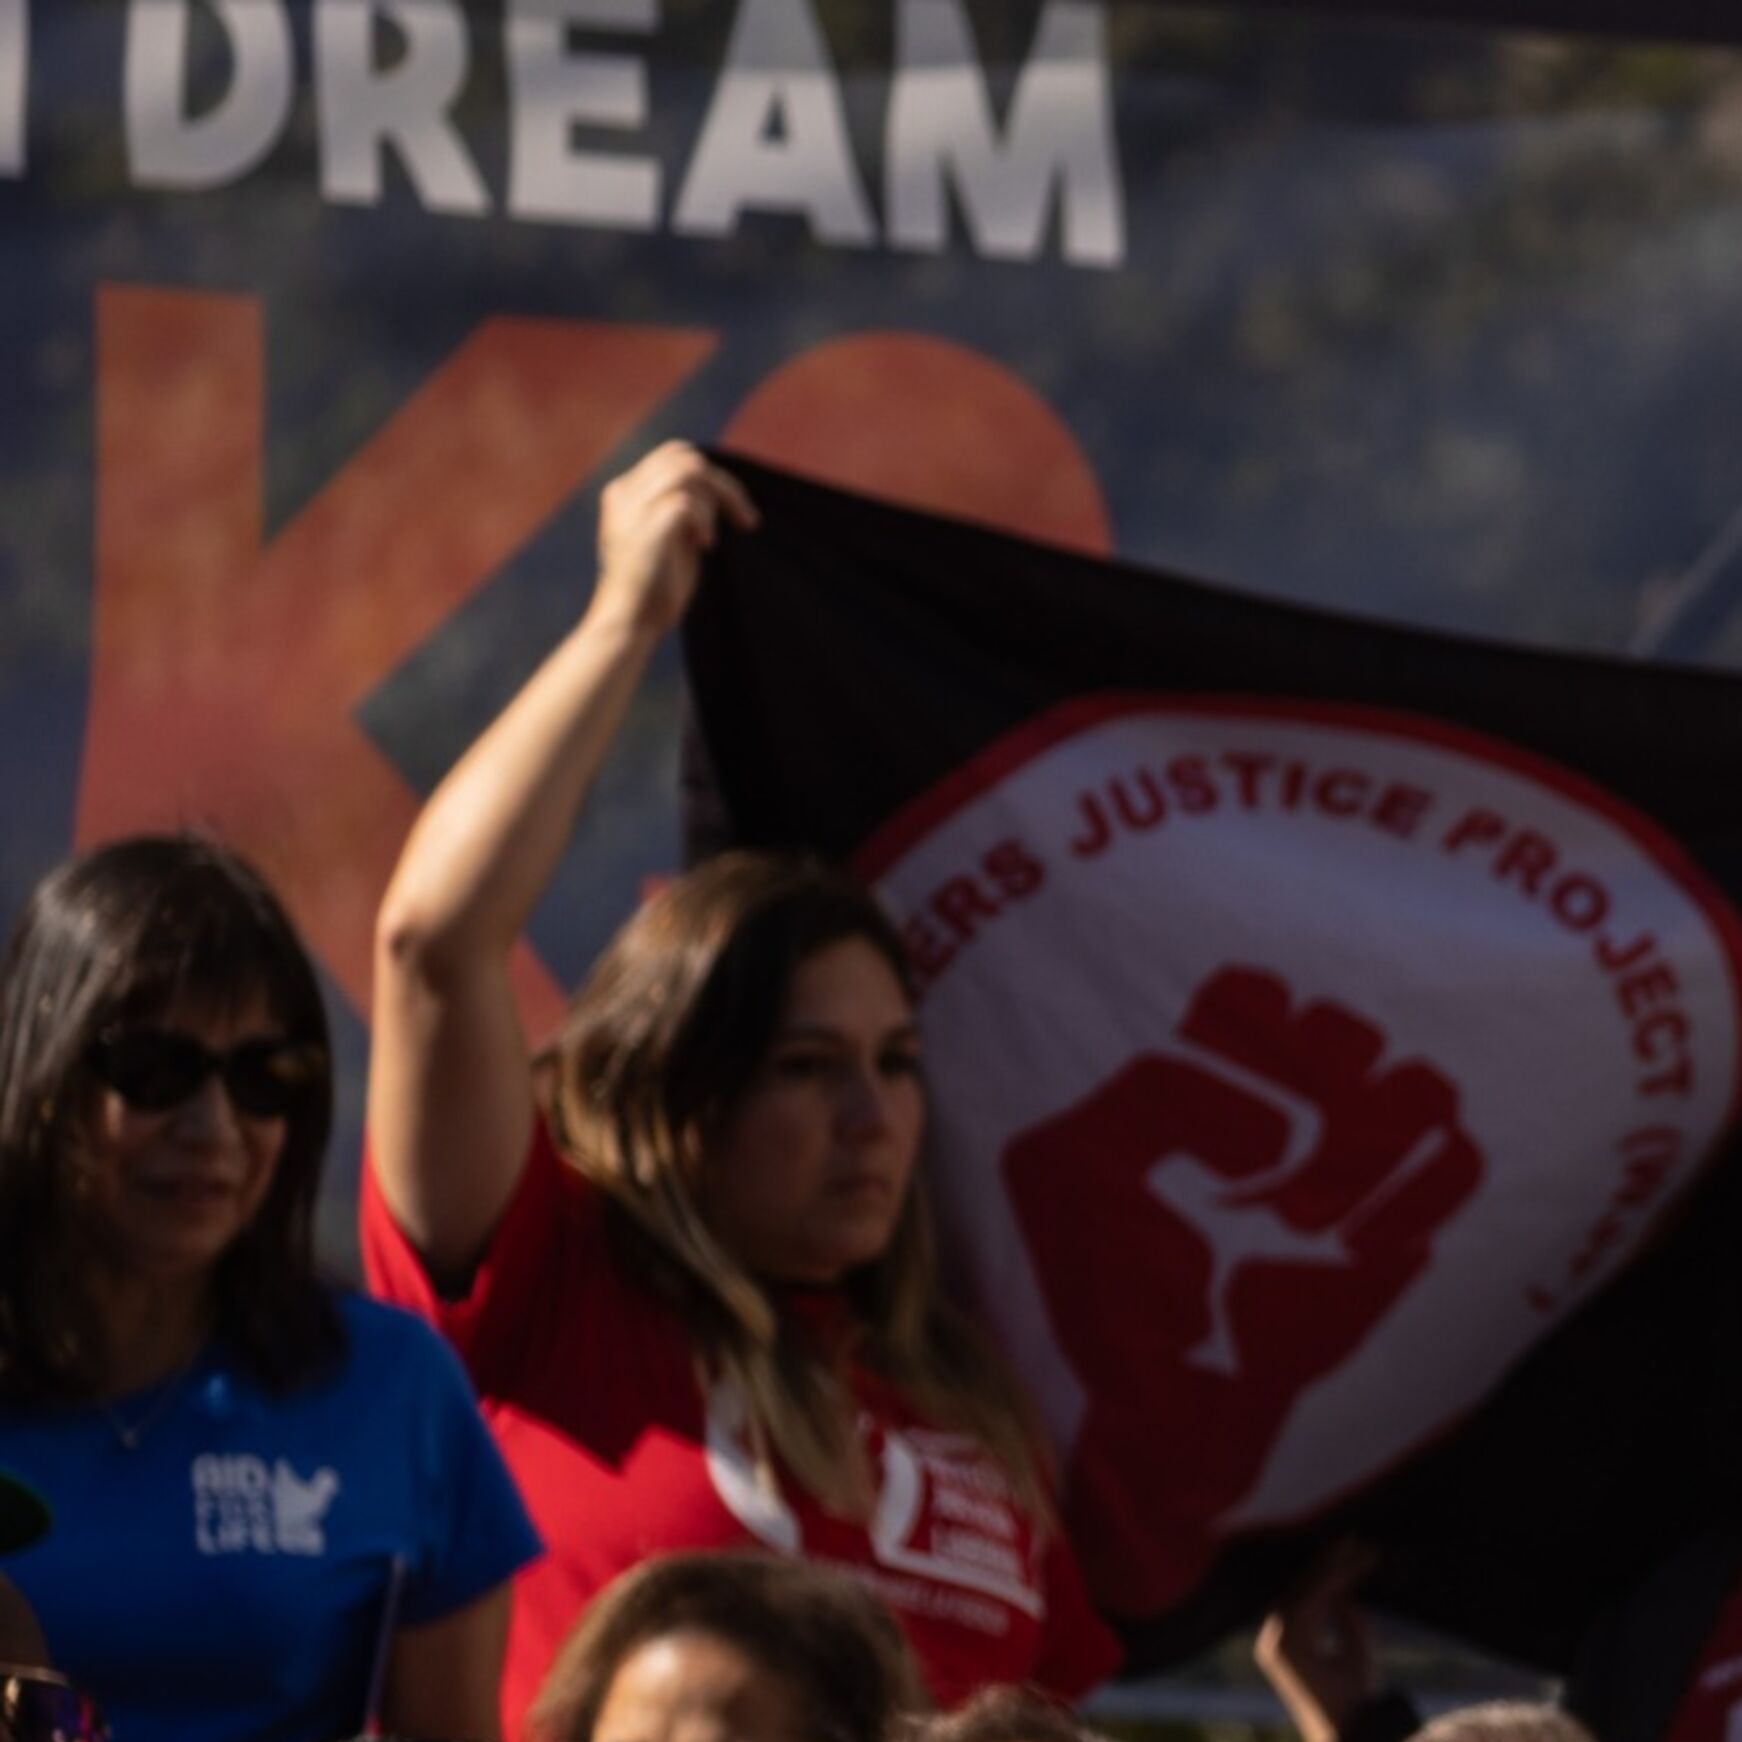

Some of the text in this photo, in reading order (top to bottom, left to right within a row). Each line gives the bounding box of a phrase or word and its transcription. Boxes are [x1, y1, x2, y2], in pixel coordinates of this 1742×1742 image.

[125, 0, 1125, 270] DREAM
[1066, 750, 1439, 862] JUSTICE
[1440, 810, 1695, 1102] PROJECT
